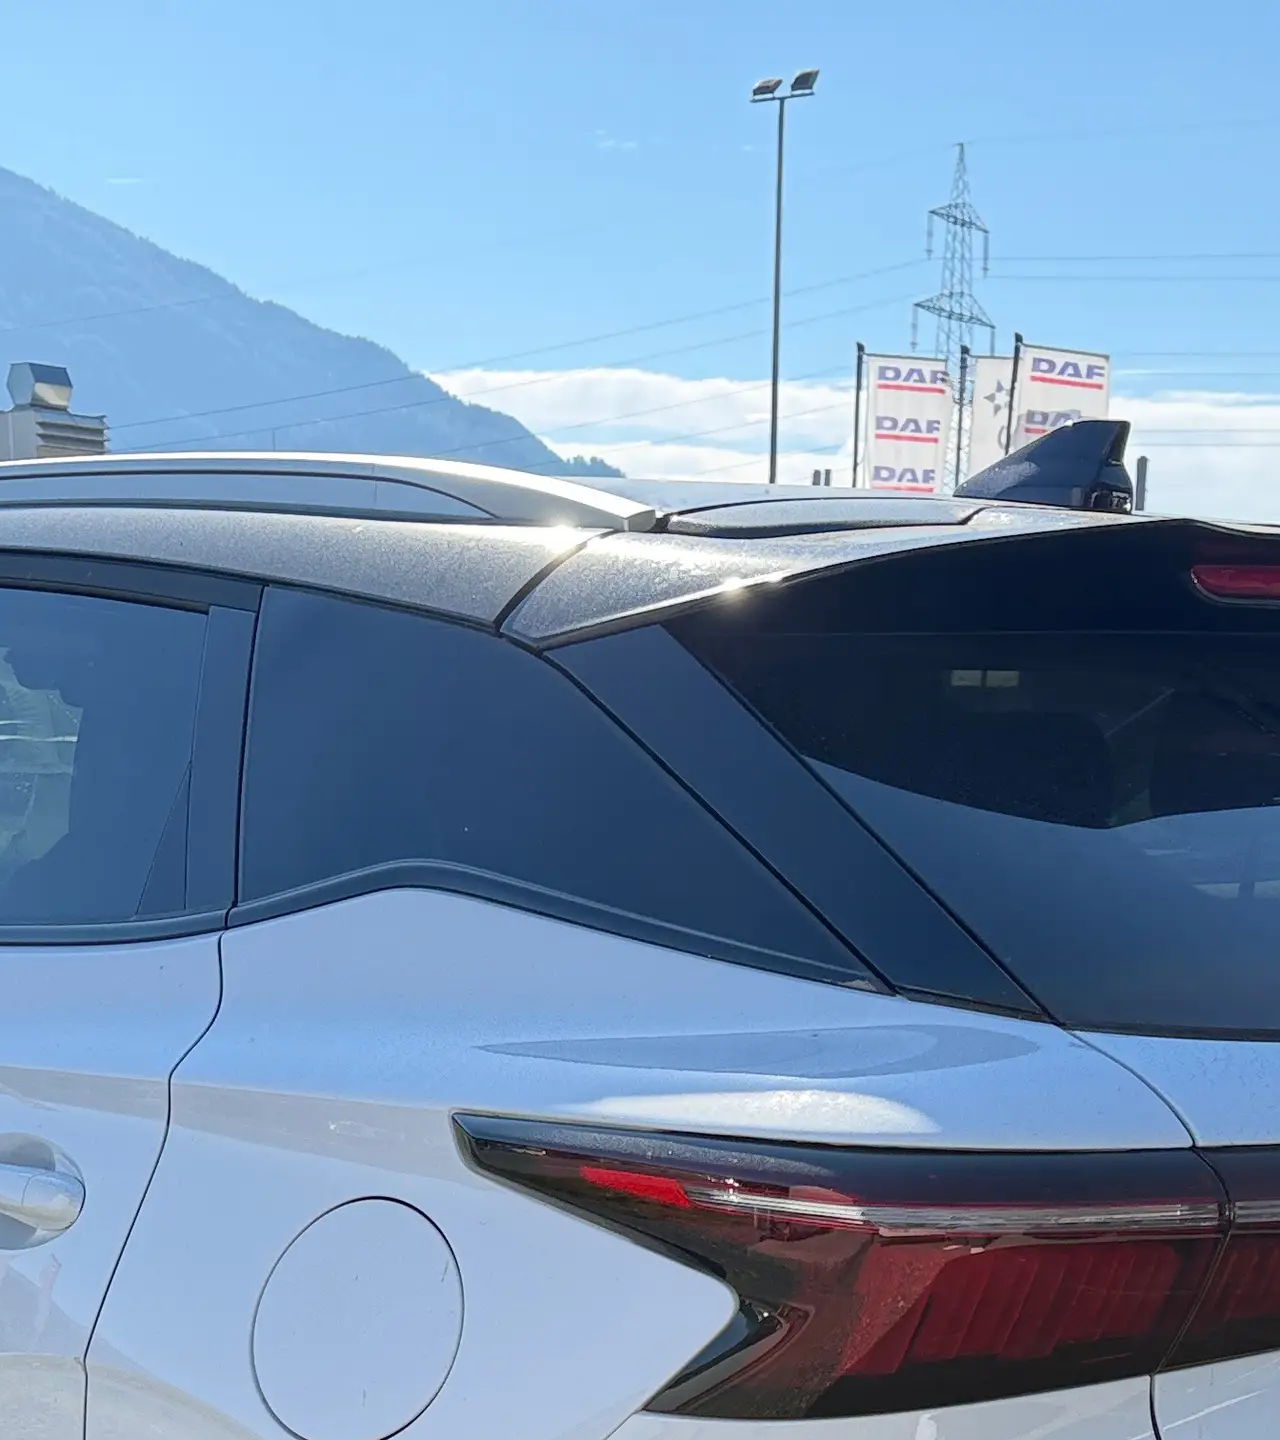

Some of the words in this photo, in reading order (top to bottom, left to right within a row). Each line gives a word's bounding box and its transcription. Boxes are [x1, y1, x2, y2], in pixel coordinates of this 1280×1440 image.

[878, 365, 949, 385] DAF
[1032, 357, 1106, 380] DAF
[875, 415, 941, 434] DAF
[872, 465, 936, 484] DAF
